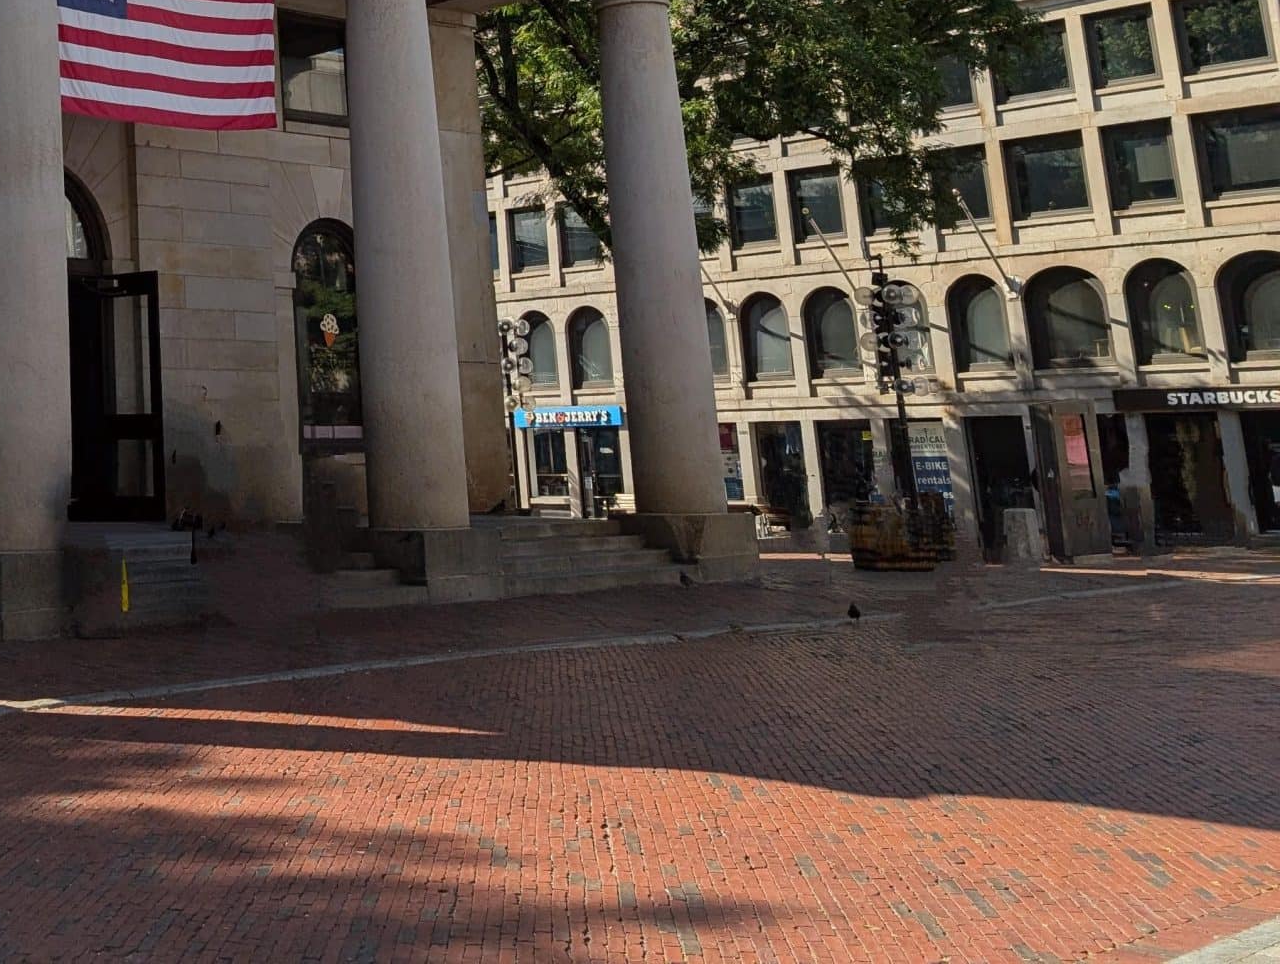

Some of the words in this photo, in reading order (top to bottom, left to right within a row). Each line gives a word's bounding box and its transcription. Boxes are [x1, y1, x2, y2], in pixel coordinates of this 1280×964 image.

[1167, 390, 1280, 405] STARBUCKS
[535, 411, 556, 423] BEN
[565, 409, 608, 423] JERRY'S
[907, 435, 945, 444] RADICAL
[916, 461, 948, 471] E-BIKE
[917, 475, 952, 486] rentals
